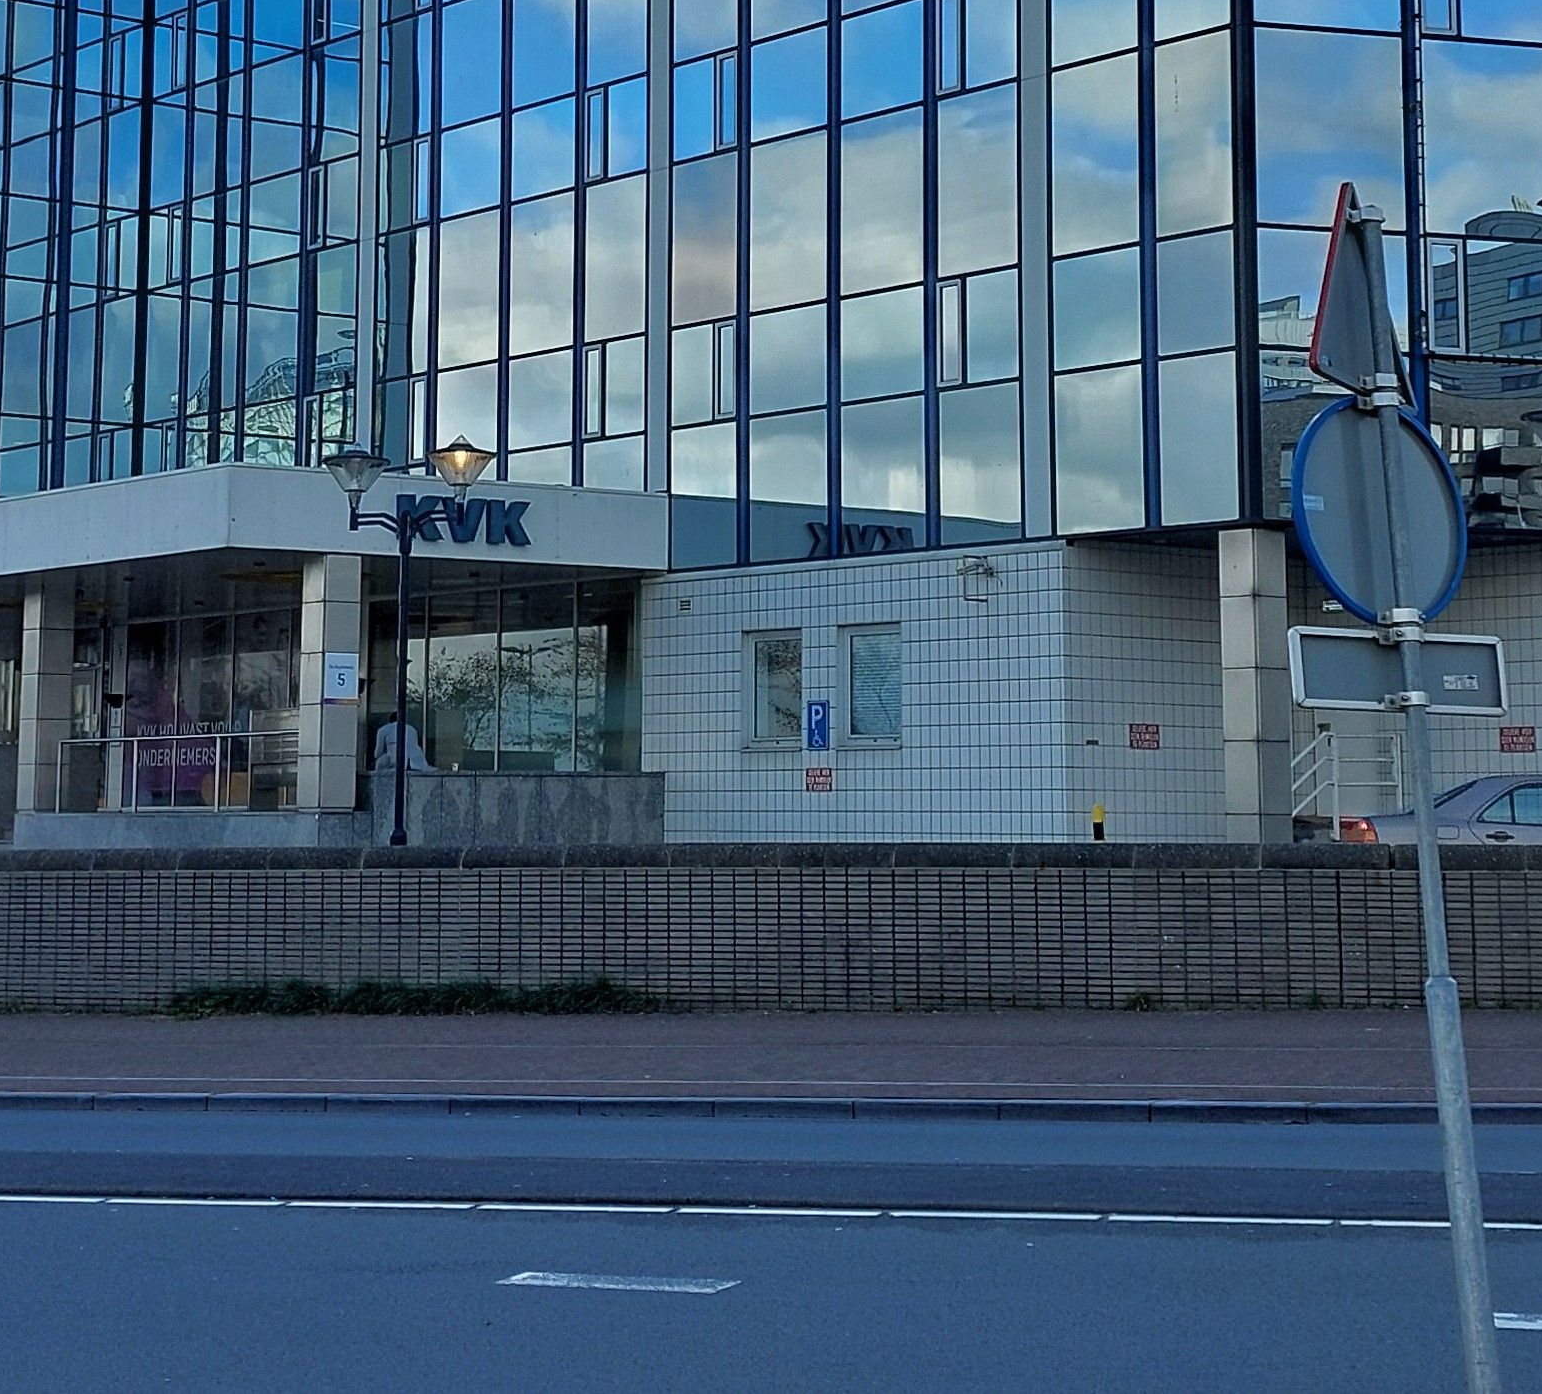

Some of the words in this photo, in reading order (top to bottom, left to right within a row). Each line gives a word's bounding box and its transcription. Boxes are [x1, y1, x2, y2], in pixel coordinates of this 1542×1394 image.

[396, 494, 532, 546] KVK
[338, 673, 346, 686] 5
[811, 705, 823, 729] P
